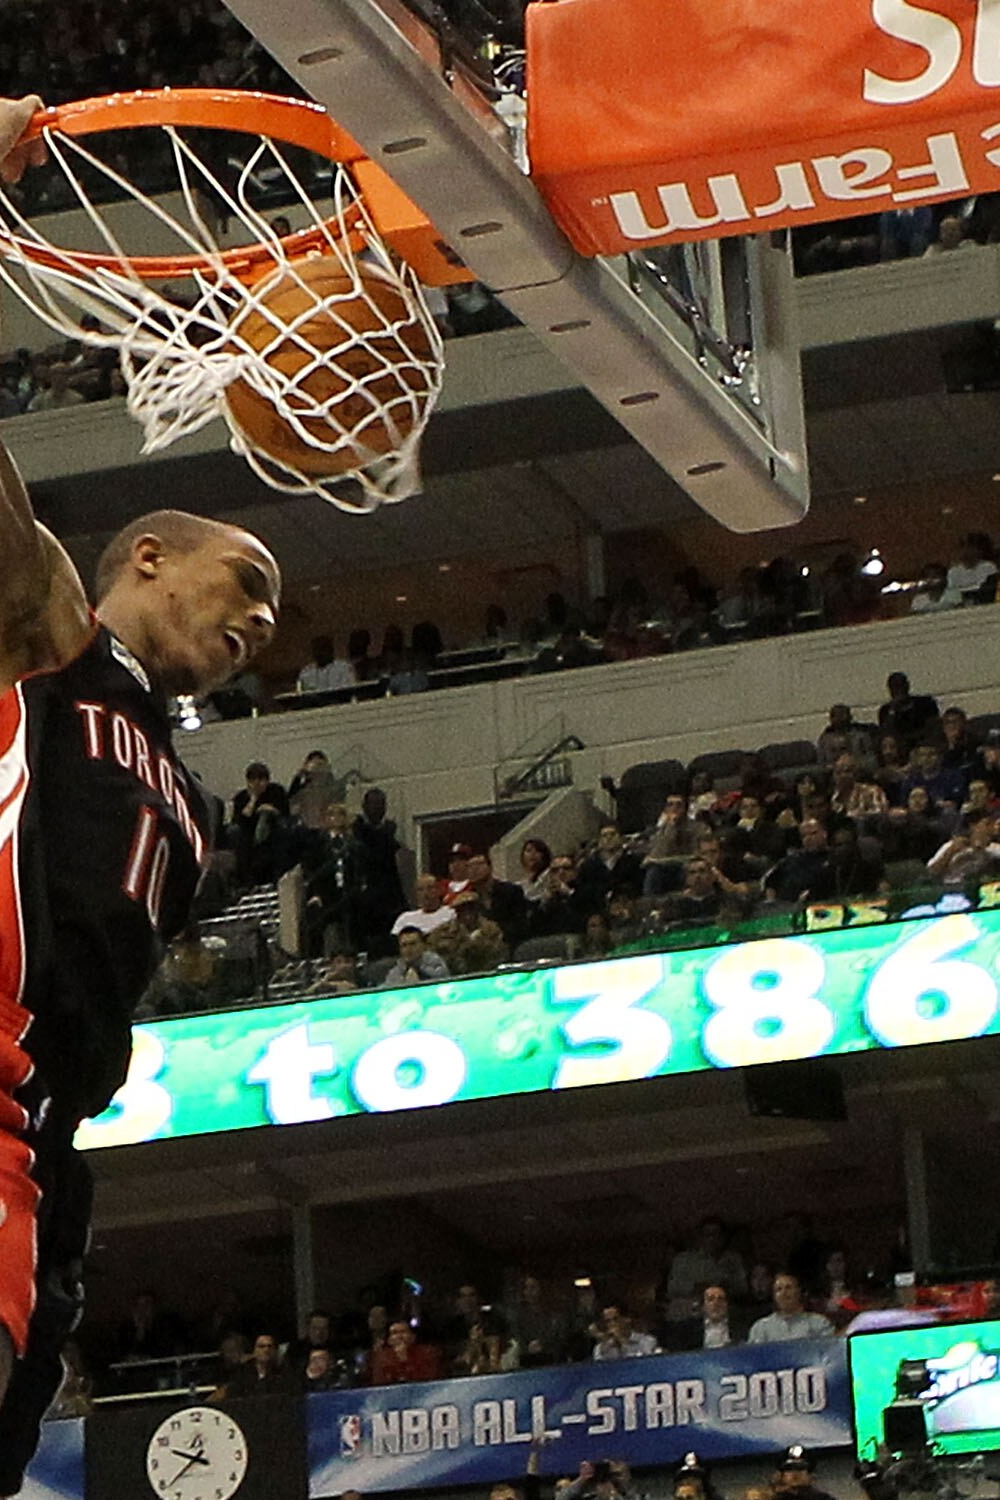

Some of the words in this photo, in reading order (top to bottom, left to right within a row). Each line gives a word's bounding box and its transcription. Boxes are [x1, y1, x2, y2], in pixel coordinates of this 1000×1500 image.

[609, 132, 970, 240] Farm
[123, 805, 170, 929] 10
[246, 1023, 467, 1126] to
[551, 914, 999, 1089] 386
[370, 1402, 459, 1457] NBA
[473, 1380, 708, 1448] ALL-STAR
[717, 1366, 827, 1422] 2010
